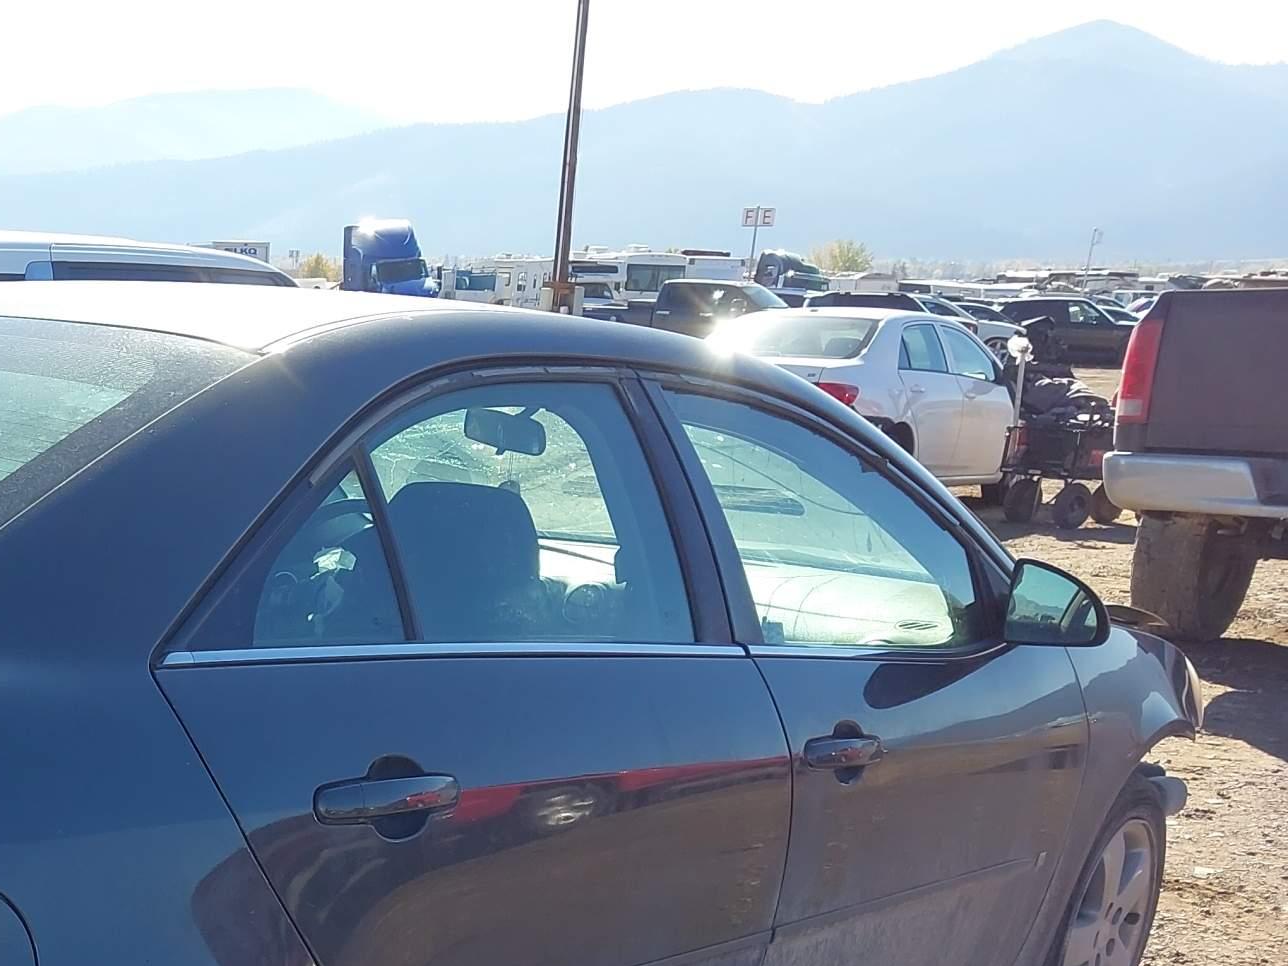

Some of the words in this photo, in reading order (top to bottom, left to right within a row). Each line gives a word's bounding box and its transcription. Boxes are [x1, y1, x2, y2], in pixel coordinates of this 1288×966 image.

[744, 209, 755, 225] F
[762, 209, 773, 225] E
[233, 247, 258, 256] LKQ
